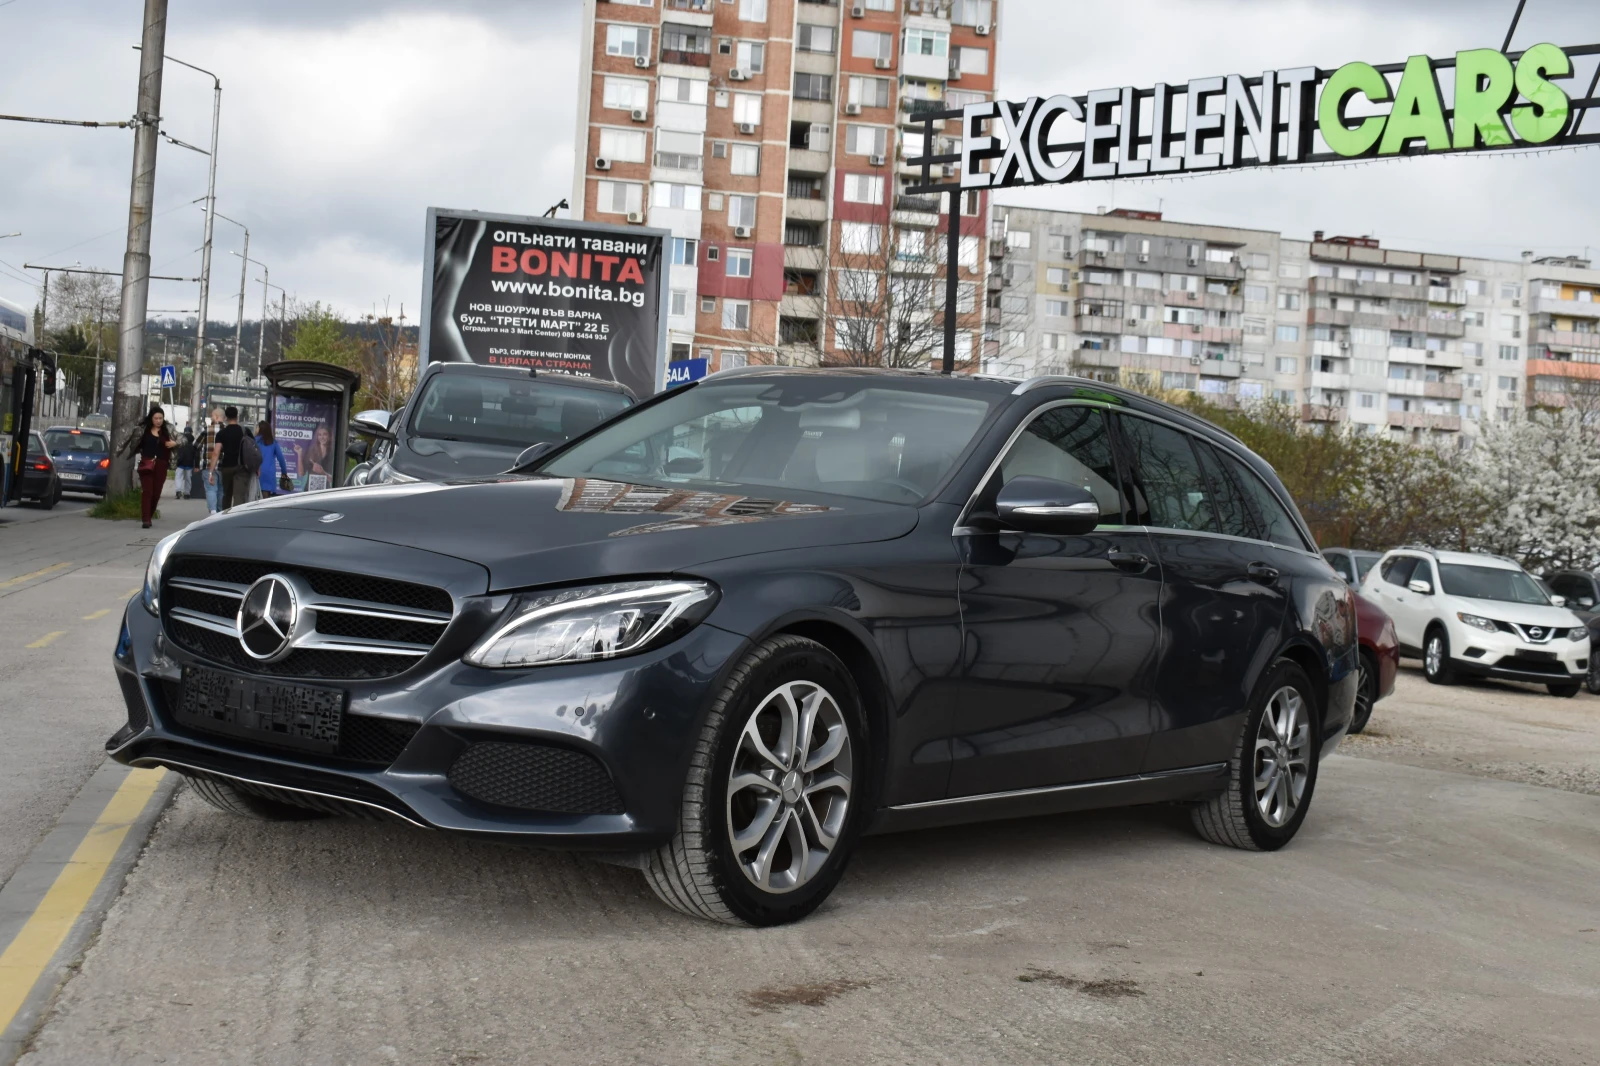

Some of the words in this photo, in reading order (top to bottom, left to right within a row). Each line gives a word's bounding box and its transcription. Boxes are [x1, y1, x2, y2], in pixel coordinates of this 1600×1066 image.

[961, 66, 1318, 188] EXCELLENT
[1318, 42, 1573, 157] CARS
[493, 230, 576, 249] опънати
[582, 237, 647, 255] тавани
[491, 245, 645, 285] BONITA
[491, 280, 645, 307] www.bonita.bg
[469, 303, 492, 312] НОВ
[494, 305, 540, 316] ШОУРУМ
[542, 308, 565, 317] ВЪВ
[567, 310, 602, 320] ВАРНА
[460, 314, 486, 325] бул.
[490, 316, 537, 328] “ТРЕТИ
[540, 319, 581, 331] МАРТ”
[584, 323, 598, 333] 22
[601, 324, 610, 333] Б
[462, 325, 498, 333] (сградата
[535, 329, 561, 338] Center)
[489, 347, 508, 356] БЪРЗ,
[510, 349, 539, 357] СИГУРЕН
[545, 351, 562, 359] ЧИСТ
[563, 353, 591, 361] МОНТАЖ
[489, 356, 497, 364] В
[500, 357, 543, 367] ЦЯЛАТА
[545, 359, 592, 370] СТРАНА!
